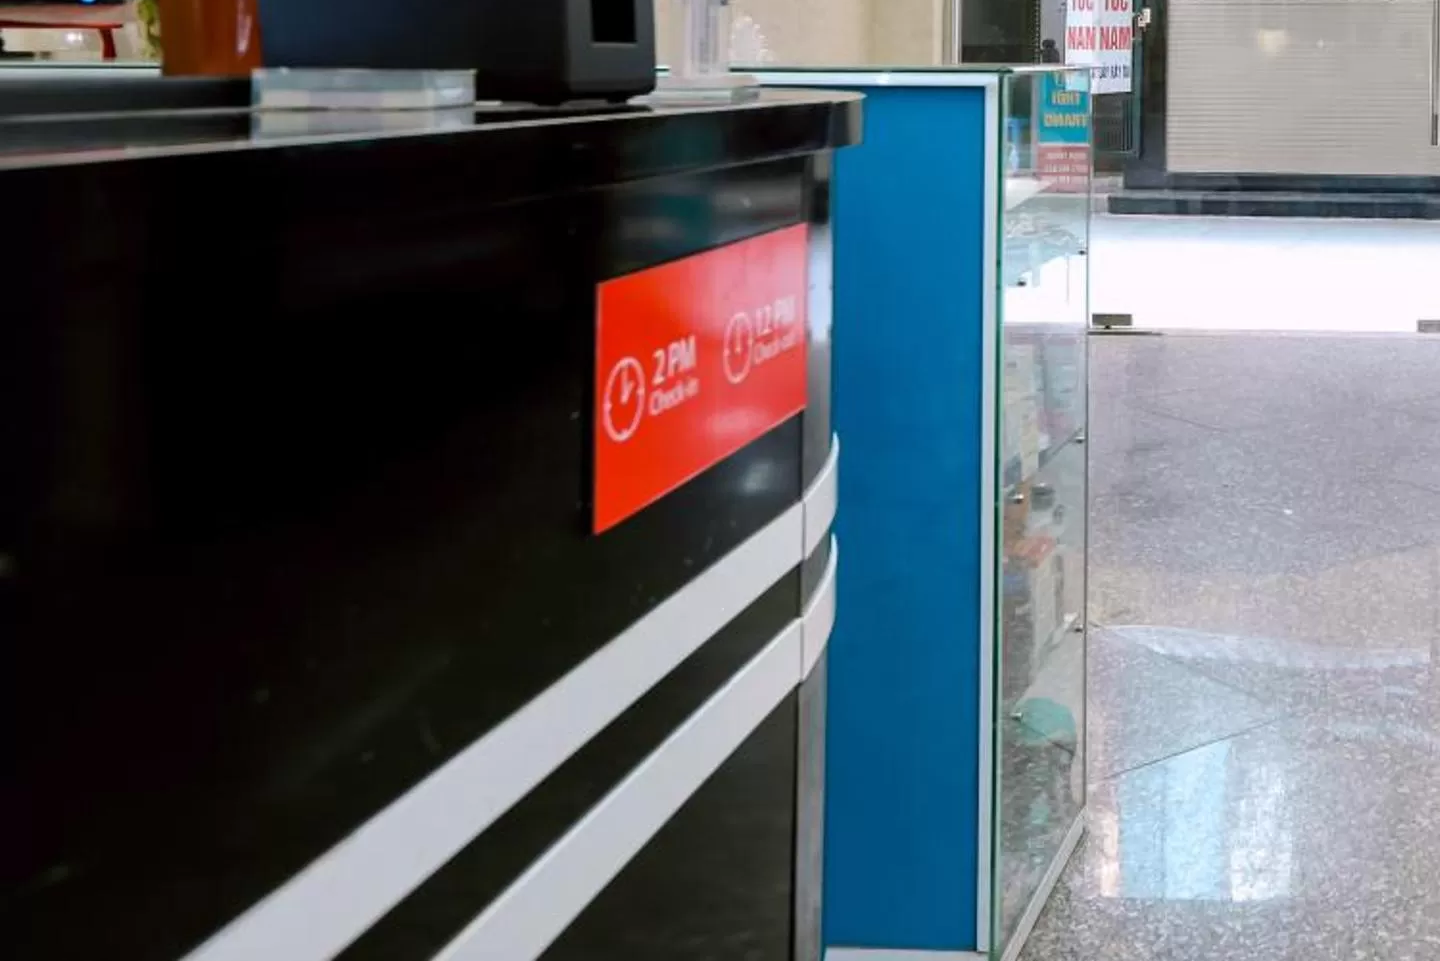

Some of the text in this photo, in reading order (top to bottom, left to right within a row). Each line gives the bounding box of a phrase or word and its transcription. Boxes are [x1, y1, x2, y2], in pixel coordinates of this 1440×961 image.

[1099, 26, 1132, 51] NAM
[652, 334, 696, 386] 2 PM
